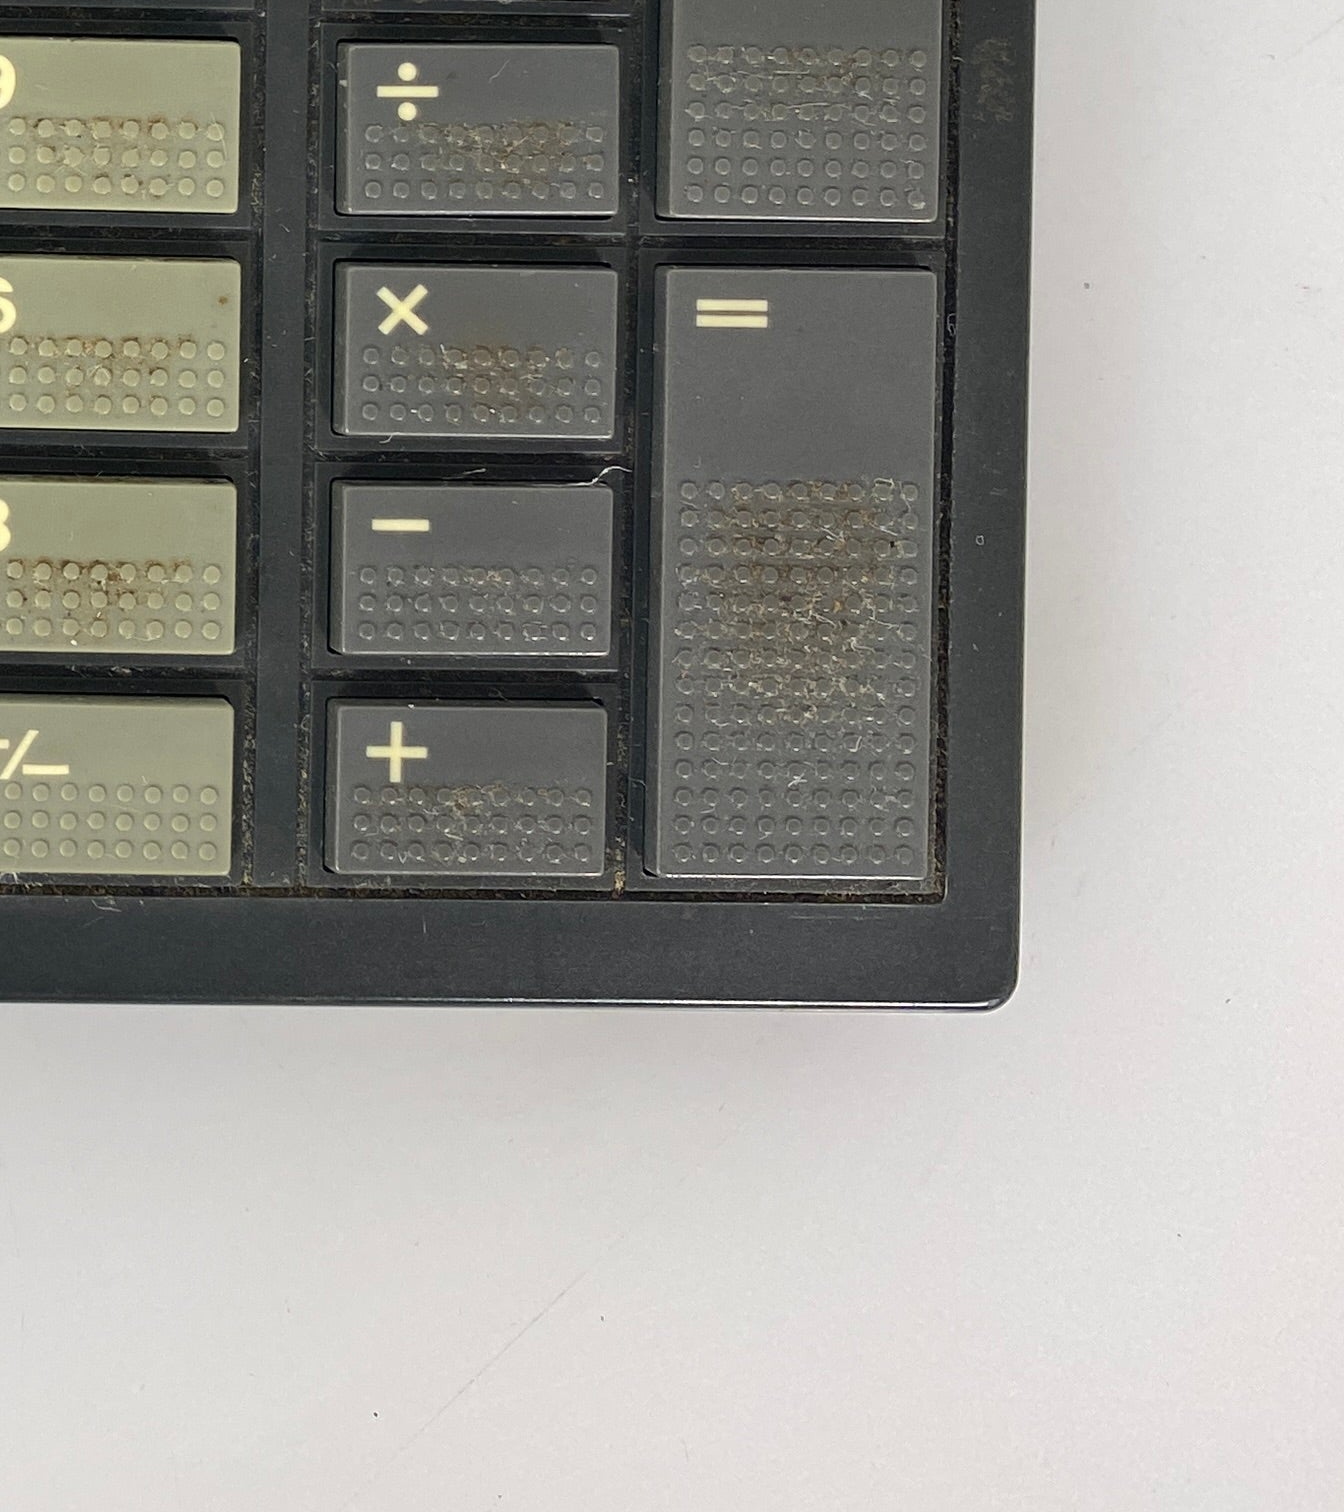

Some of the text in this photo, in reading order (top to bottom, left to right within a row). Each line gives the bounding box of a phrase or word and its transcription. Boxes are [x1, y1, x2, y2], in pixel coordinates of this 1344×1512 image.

[377, 63, 438, 121] ÷
[696, 299, 768, 328] =
[366, 722, 427, 782] +
